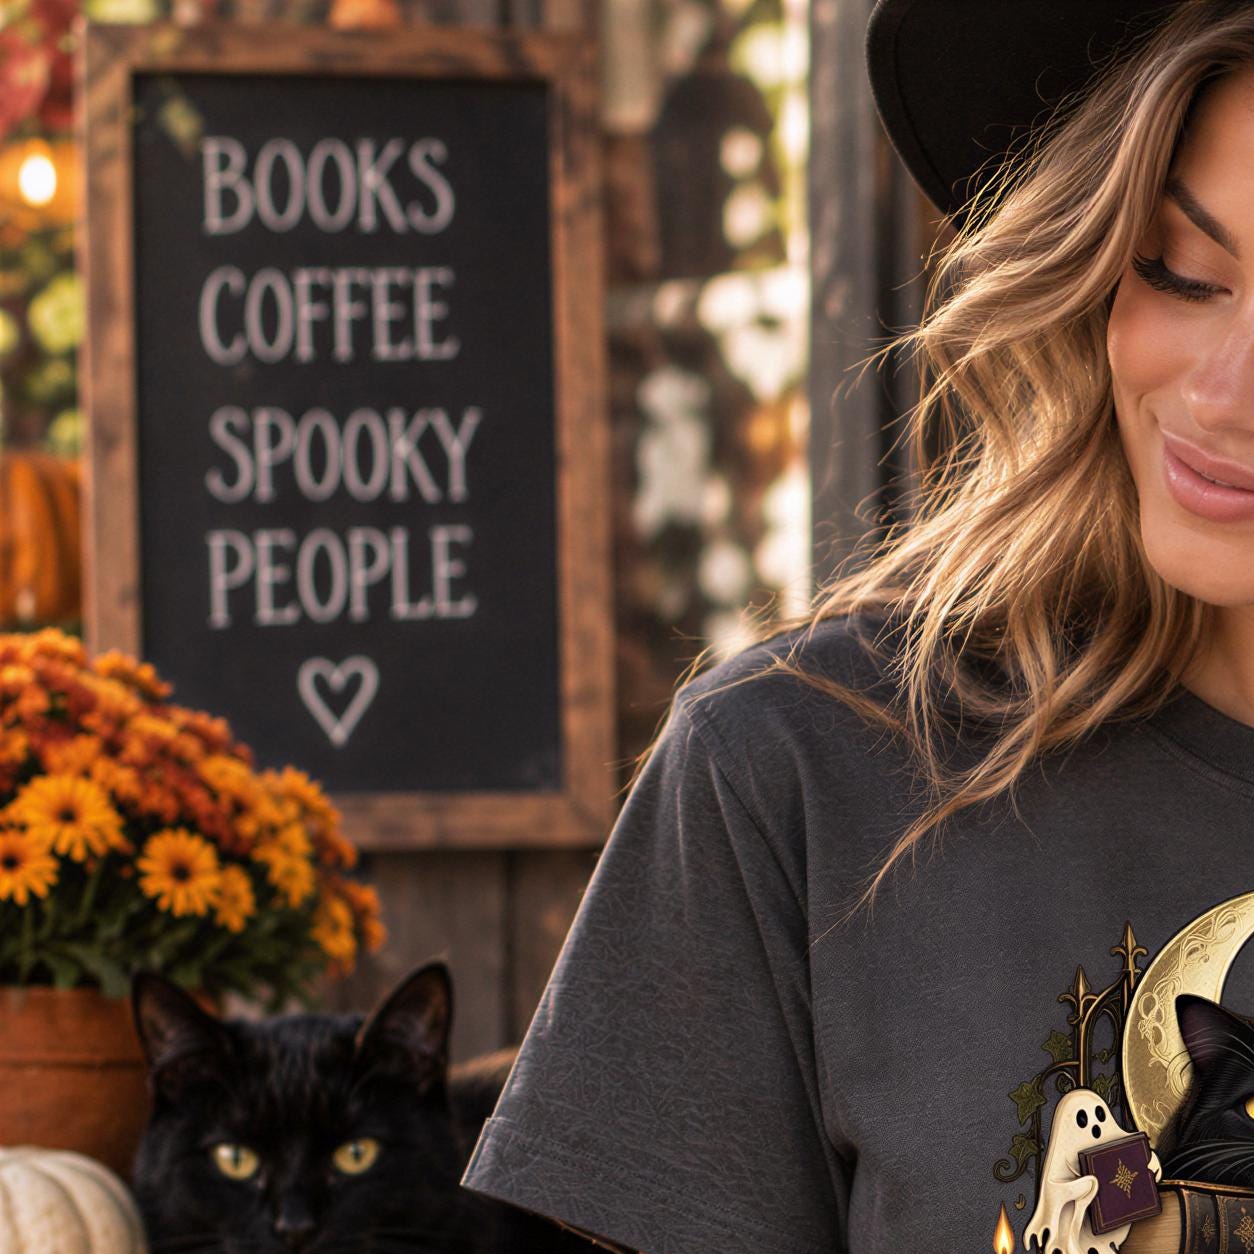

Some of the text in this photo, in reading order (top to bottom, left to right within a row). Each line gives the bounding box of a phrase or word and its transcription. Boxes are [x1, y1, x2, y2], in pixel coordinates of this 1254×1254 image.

[202, 137, 454, 235] BOOKS
[199, 266, 459, 365] COFFEE
[205, 406, 481, 503] SPOOKY
[206, 525, 477, 629] PEOPLE
